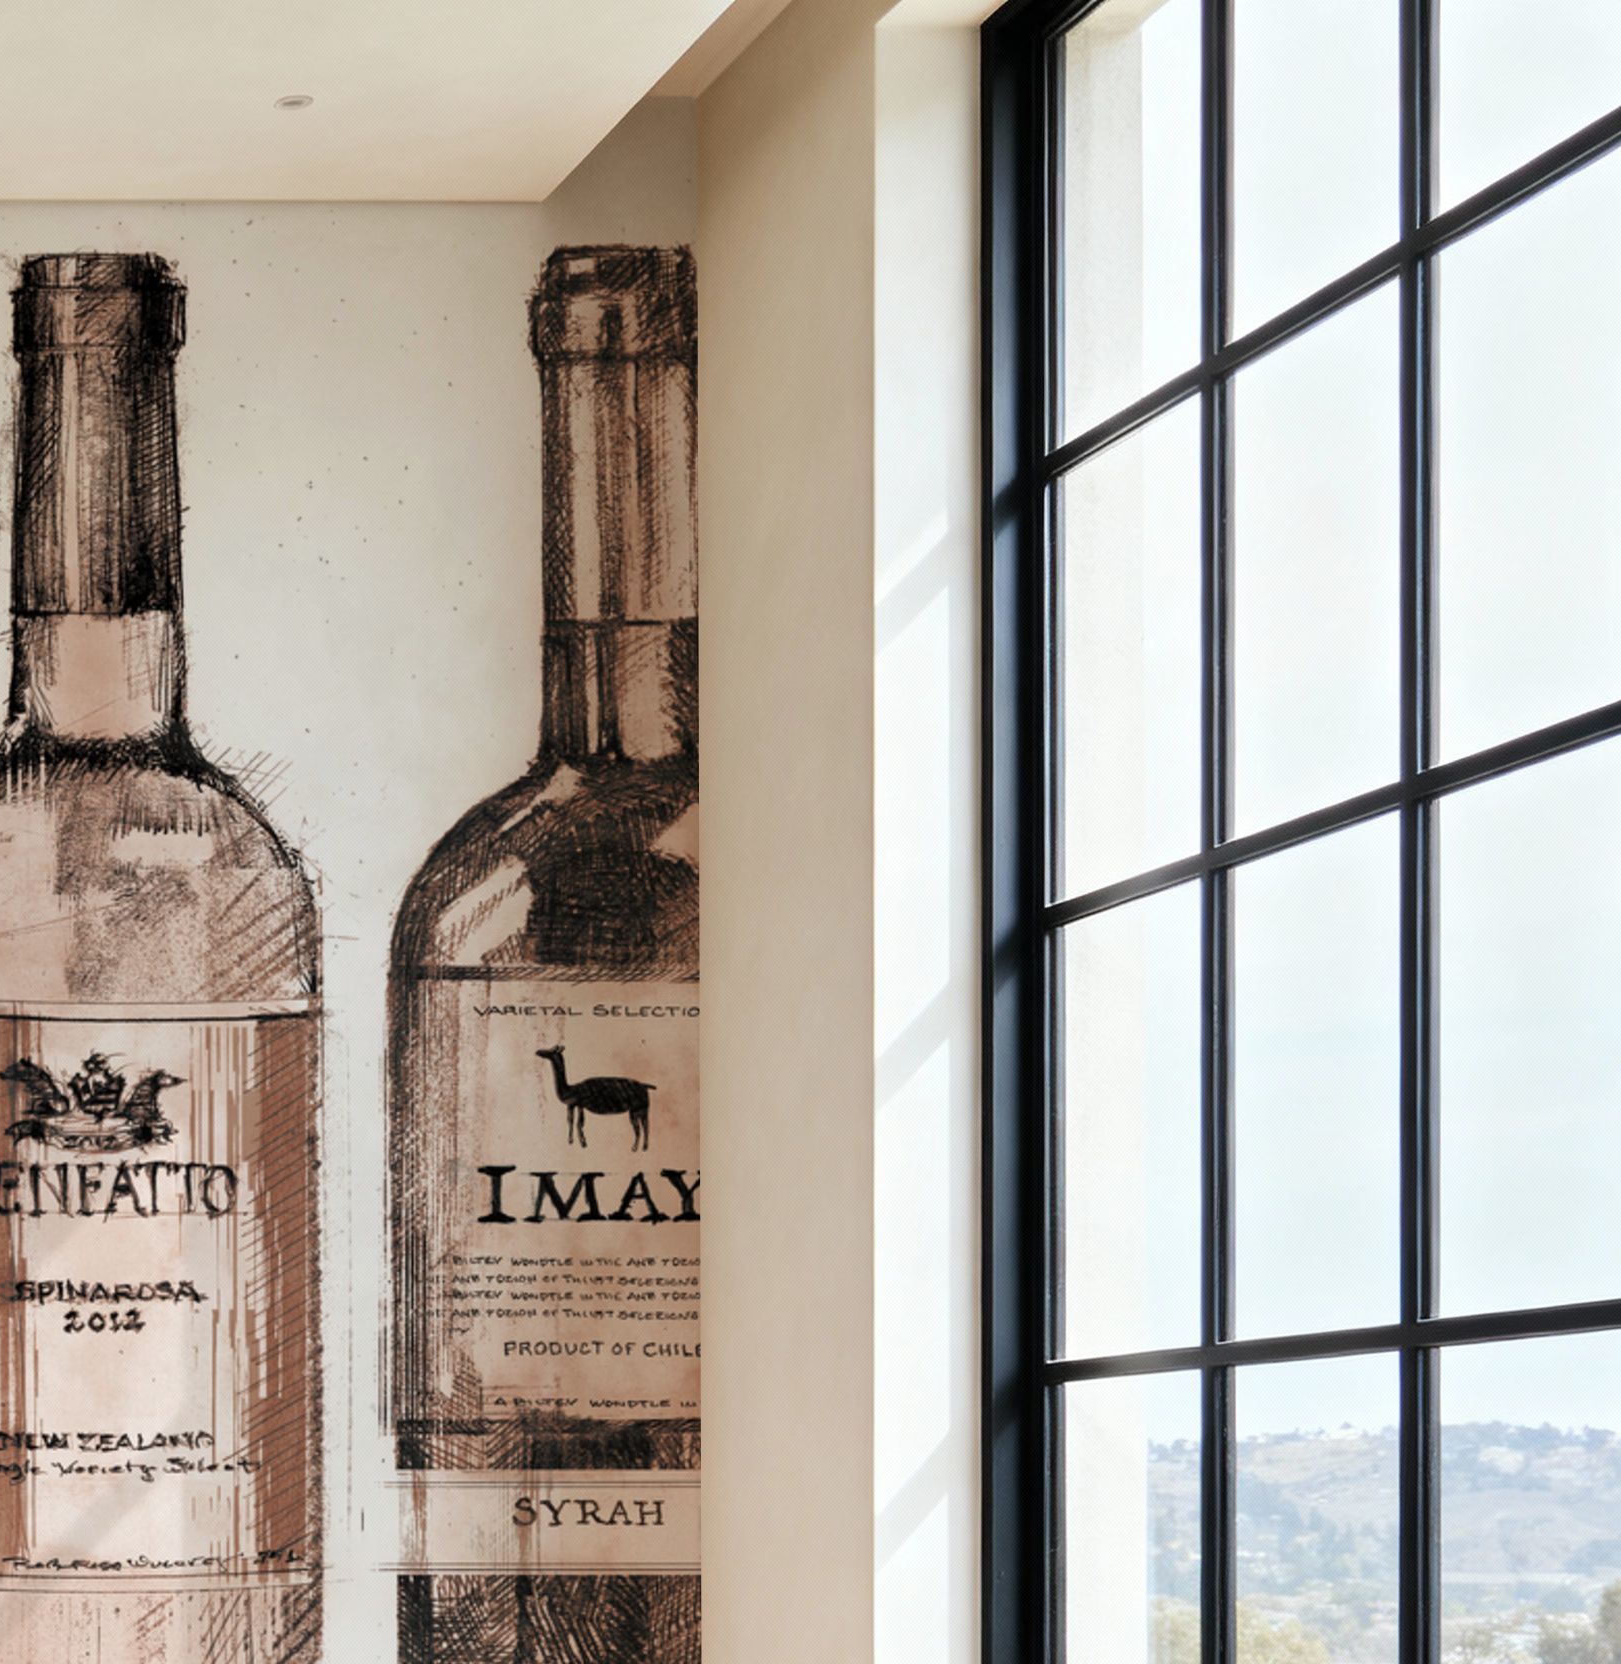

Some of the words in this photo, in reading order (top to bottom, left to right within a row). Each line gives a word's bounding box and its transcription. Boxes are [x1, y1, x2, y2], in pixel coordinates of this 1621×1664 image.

[473, 1004, 583, 1018] VARIETAL
[593, 1004, 701, 1018] SELECTIO
[476, 1164, 701, 1226] IMAY
[62, 1308, 147, 1334] 2012
[503, 1340, 603, 1357] PRODUCT
[612, 1341, 636, 1356] OF
[511, 1497, 666, 1528] SYRAH
